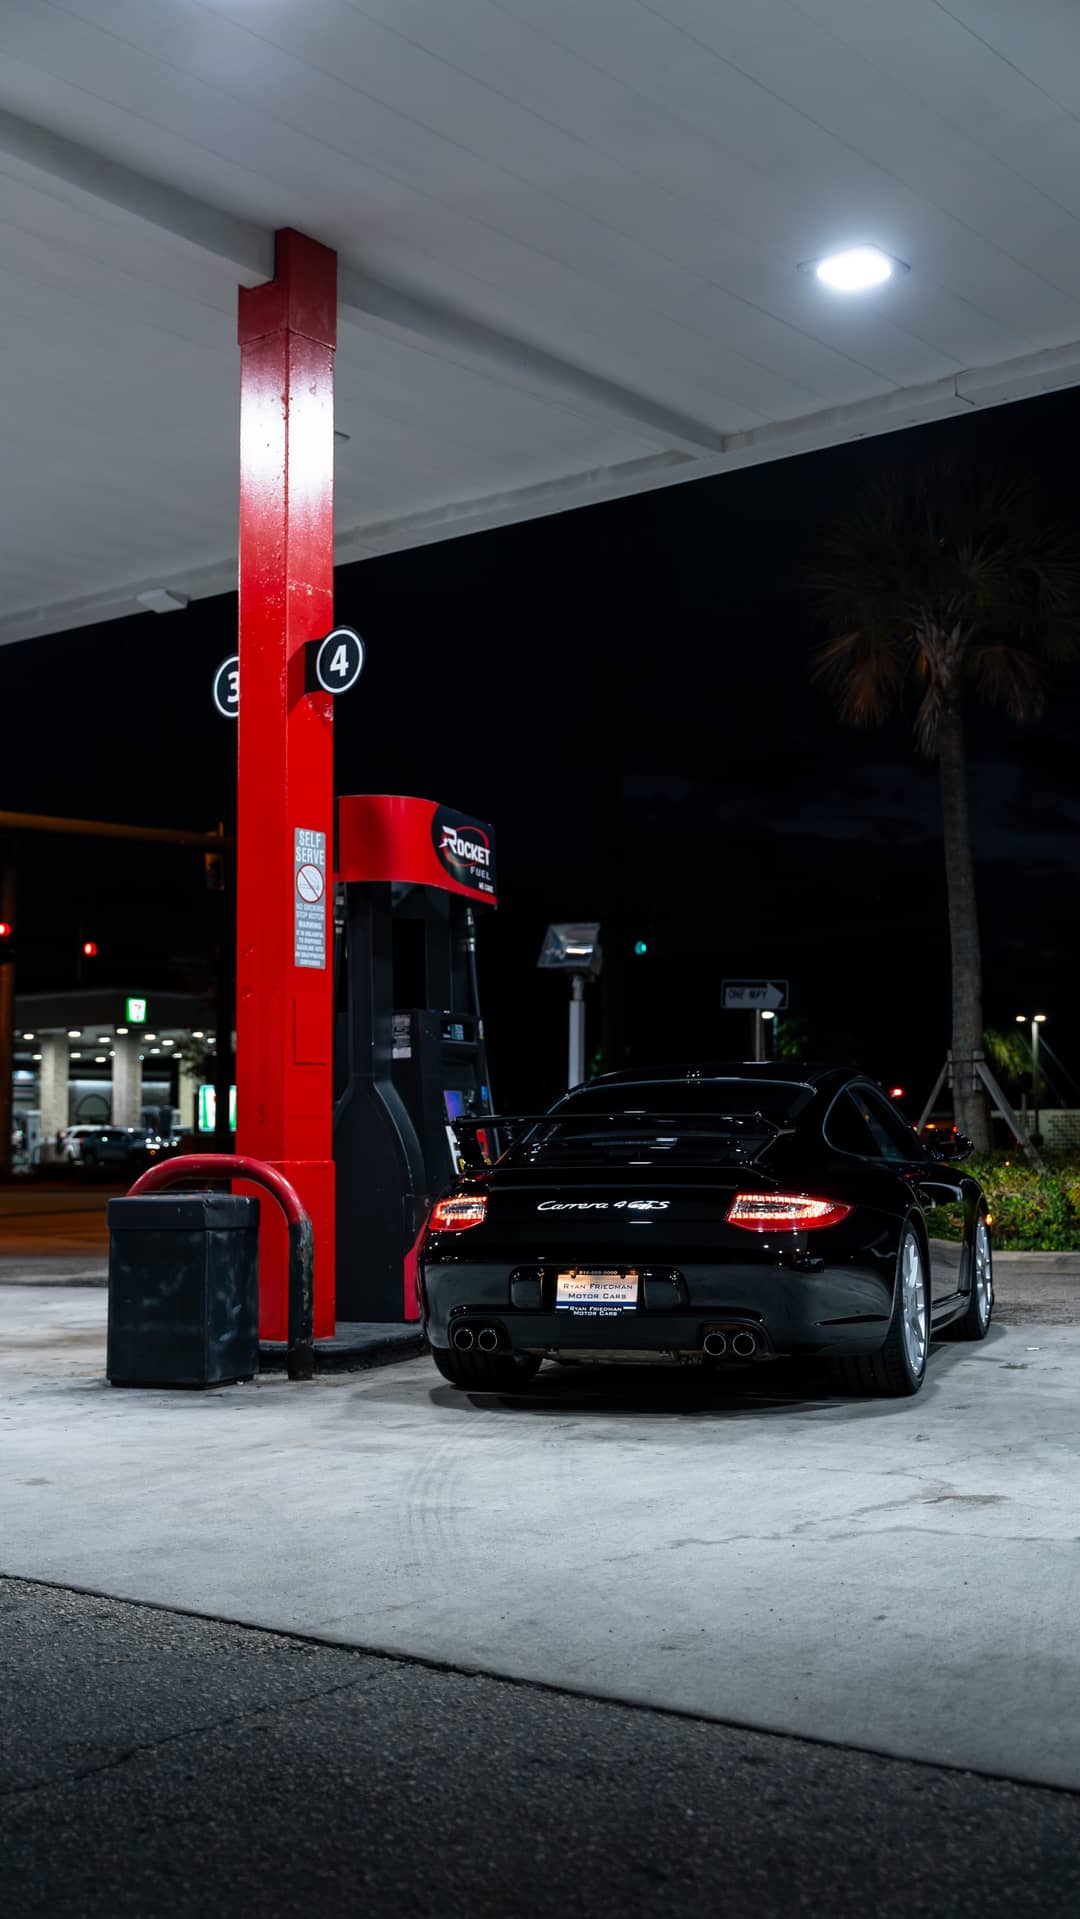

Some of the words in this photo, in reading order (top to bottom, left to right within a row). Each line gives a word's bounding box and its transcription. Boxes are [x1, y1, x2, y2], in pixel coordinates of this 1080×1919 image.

[330, 644, 349, 677] 4
[227, 671, 239, 704] 3
[299, 830, 321, 848] SELF
[439, 825, 490, 866] ROCKET
[296, 846, 325, 865] SERVE
[470, 866, 491, 880] FUEL
[537, 1200, 609, 1210] Carrera
